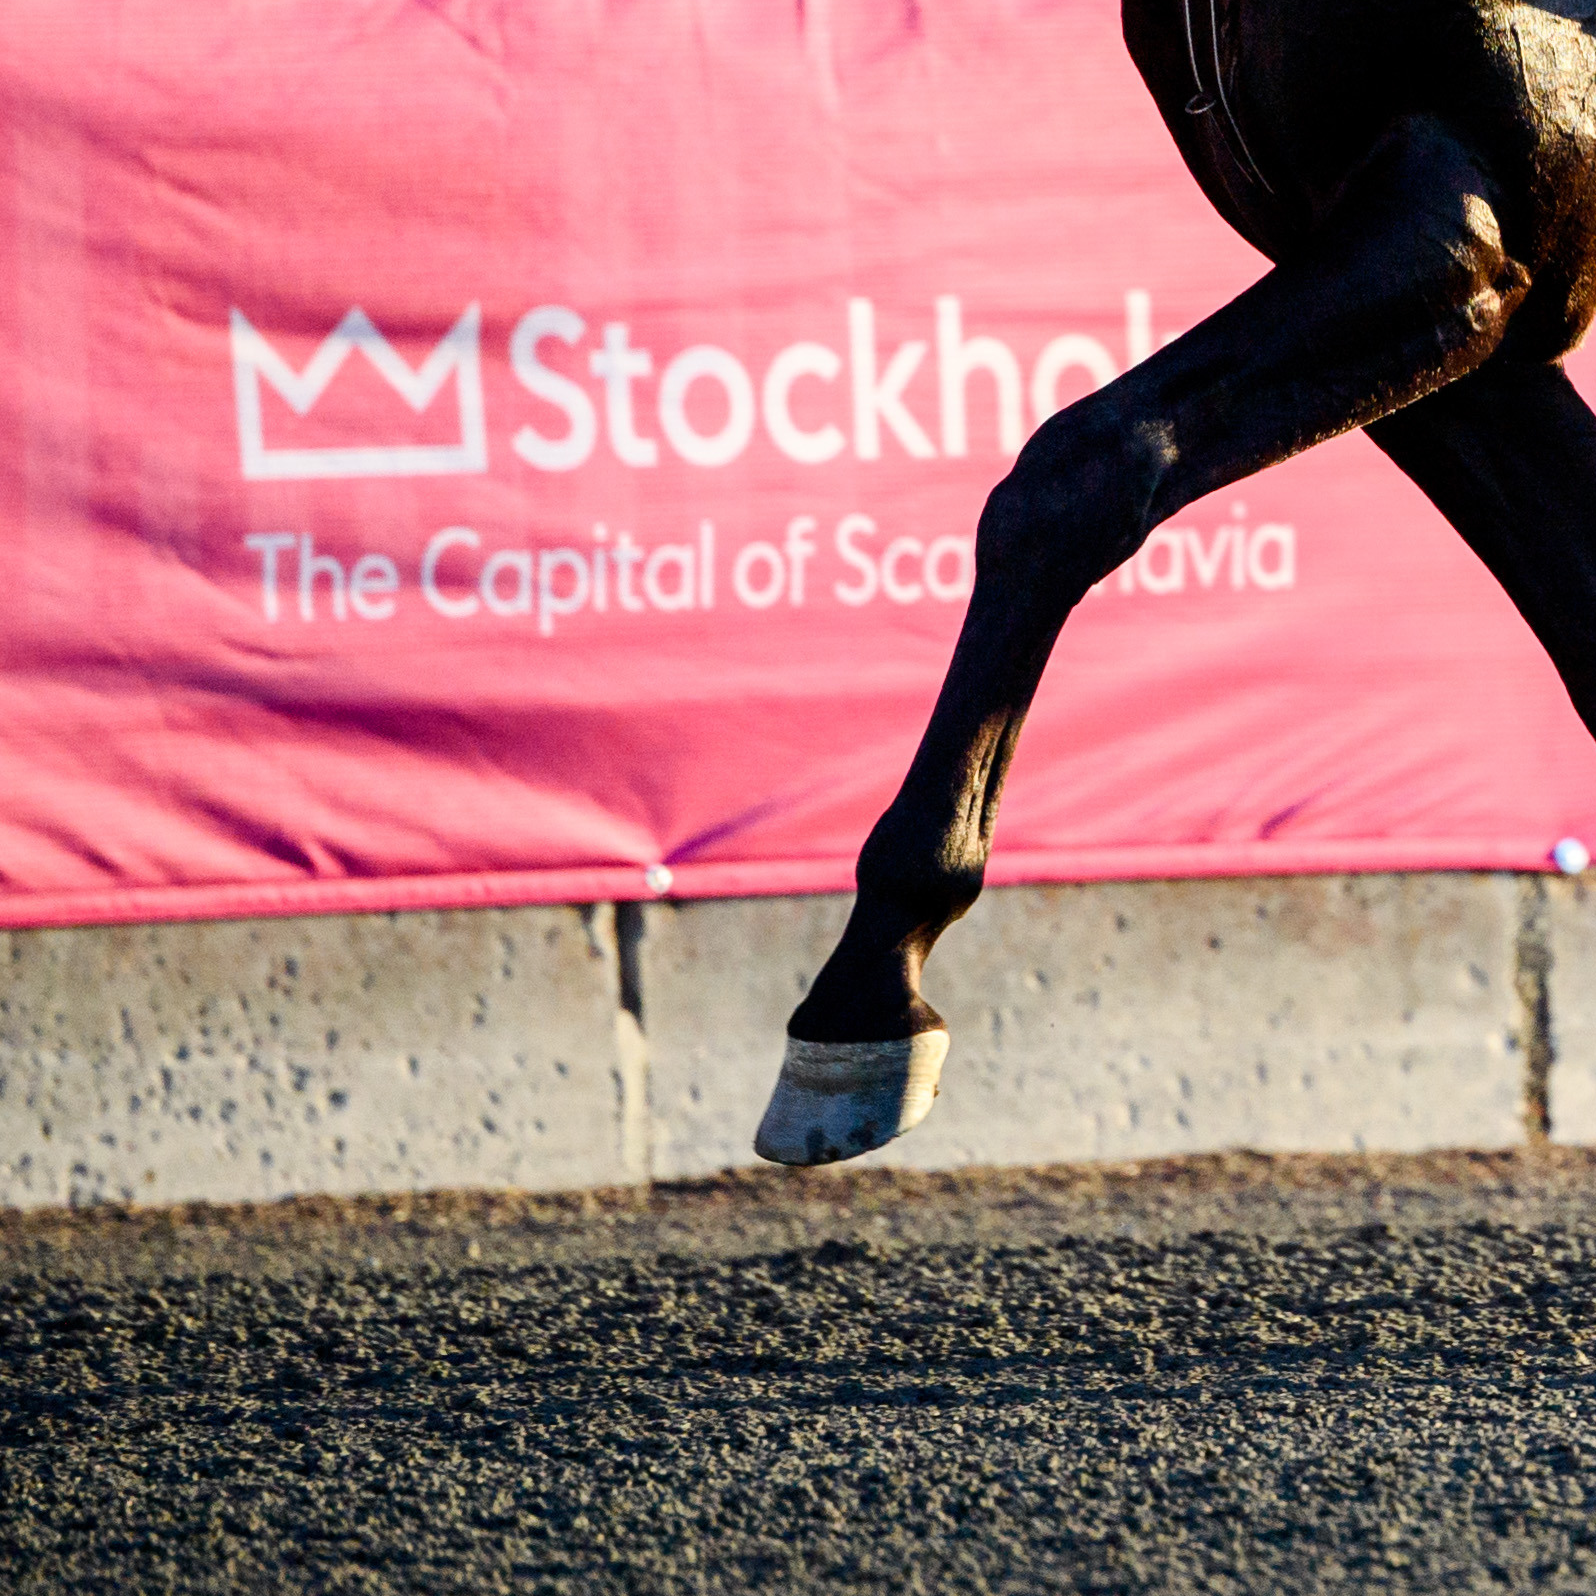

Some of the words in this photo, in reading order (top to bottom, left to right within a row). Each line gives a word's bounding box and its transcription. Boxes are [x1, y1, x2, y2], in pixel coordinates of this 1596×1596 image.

[509, 290, 1188, 470] Stockho
[244, 532, 399, 621] The
[420, 521, 715, 635] Capital
[732, 515, 818, 612] of
[835, 501, 1298, 606] Scaavia
